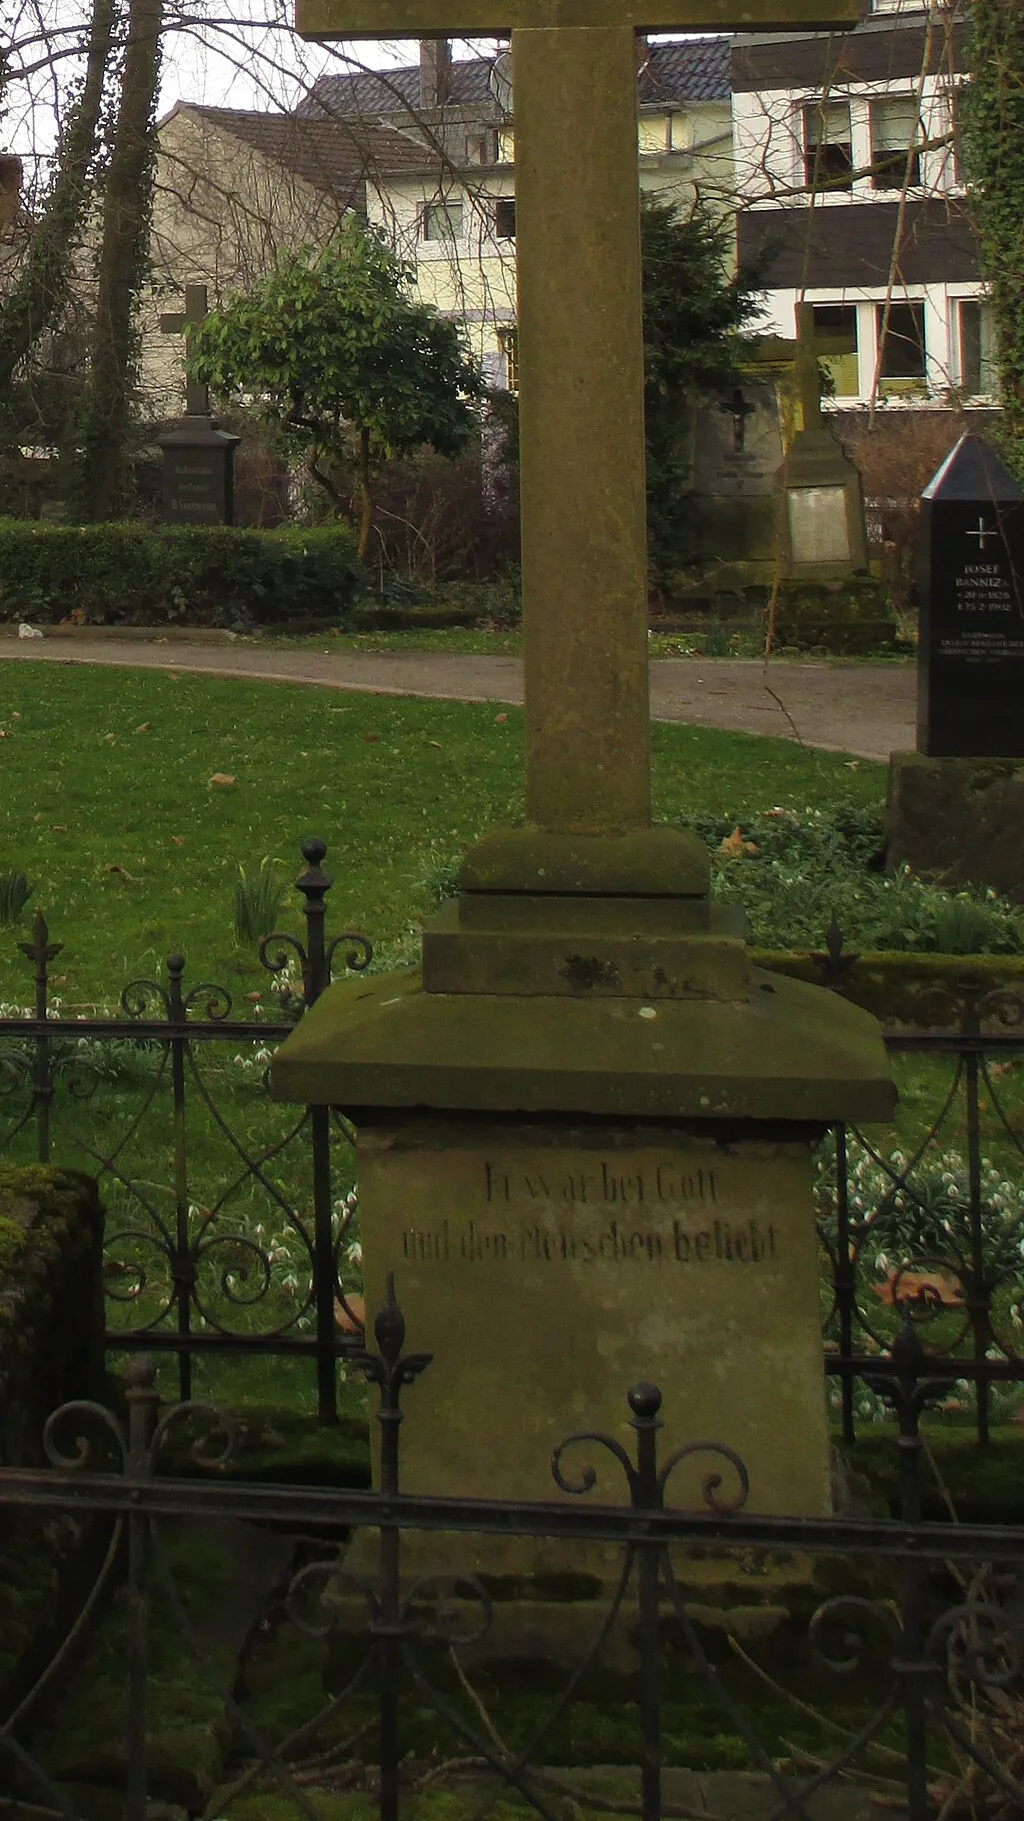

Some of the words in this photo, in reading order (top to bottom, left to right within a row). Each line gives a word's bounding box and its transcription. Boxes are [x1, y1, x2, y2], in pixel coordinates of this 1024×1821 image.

[524, 1174, 593, 1203] war
[598, 1160, 644, 1203] bei
[656, 1161, 720, 1203] Gott
[401, 1219, 450, 1262] und
[460, 1219, 507, 1262] den
[521, 1219, 662, 1263] Menschen
[672, 1218, 780, 1263] beliebt
